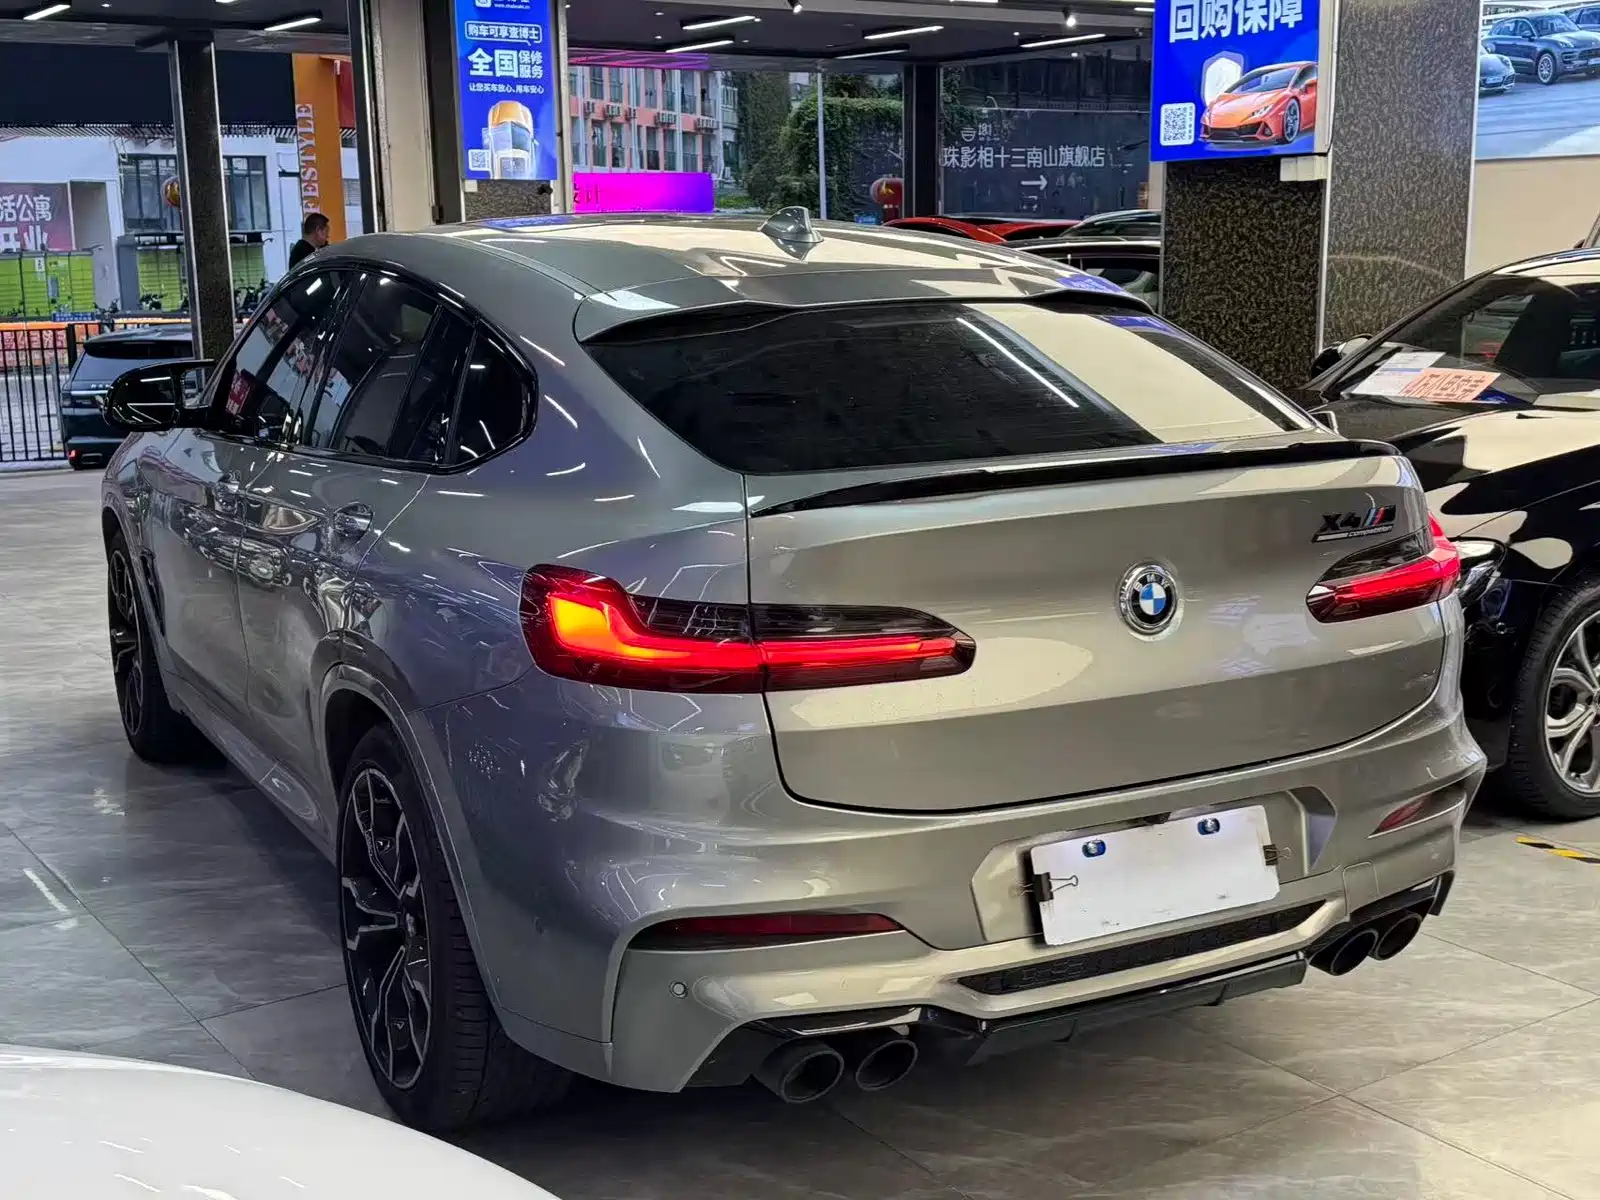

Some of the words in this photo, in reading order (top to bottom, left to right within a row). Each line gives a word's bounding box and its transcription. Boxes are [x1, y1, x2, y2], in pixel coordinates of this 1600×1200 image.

[1169, 0, 1303, 43] 回购保障
[468, 23, 539, 39] 购车可享查博士
[467, 47, 519, 78] 全国
[519, 50, 543, 65] 保修
[519, 65, 543, 79] 服务
